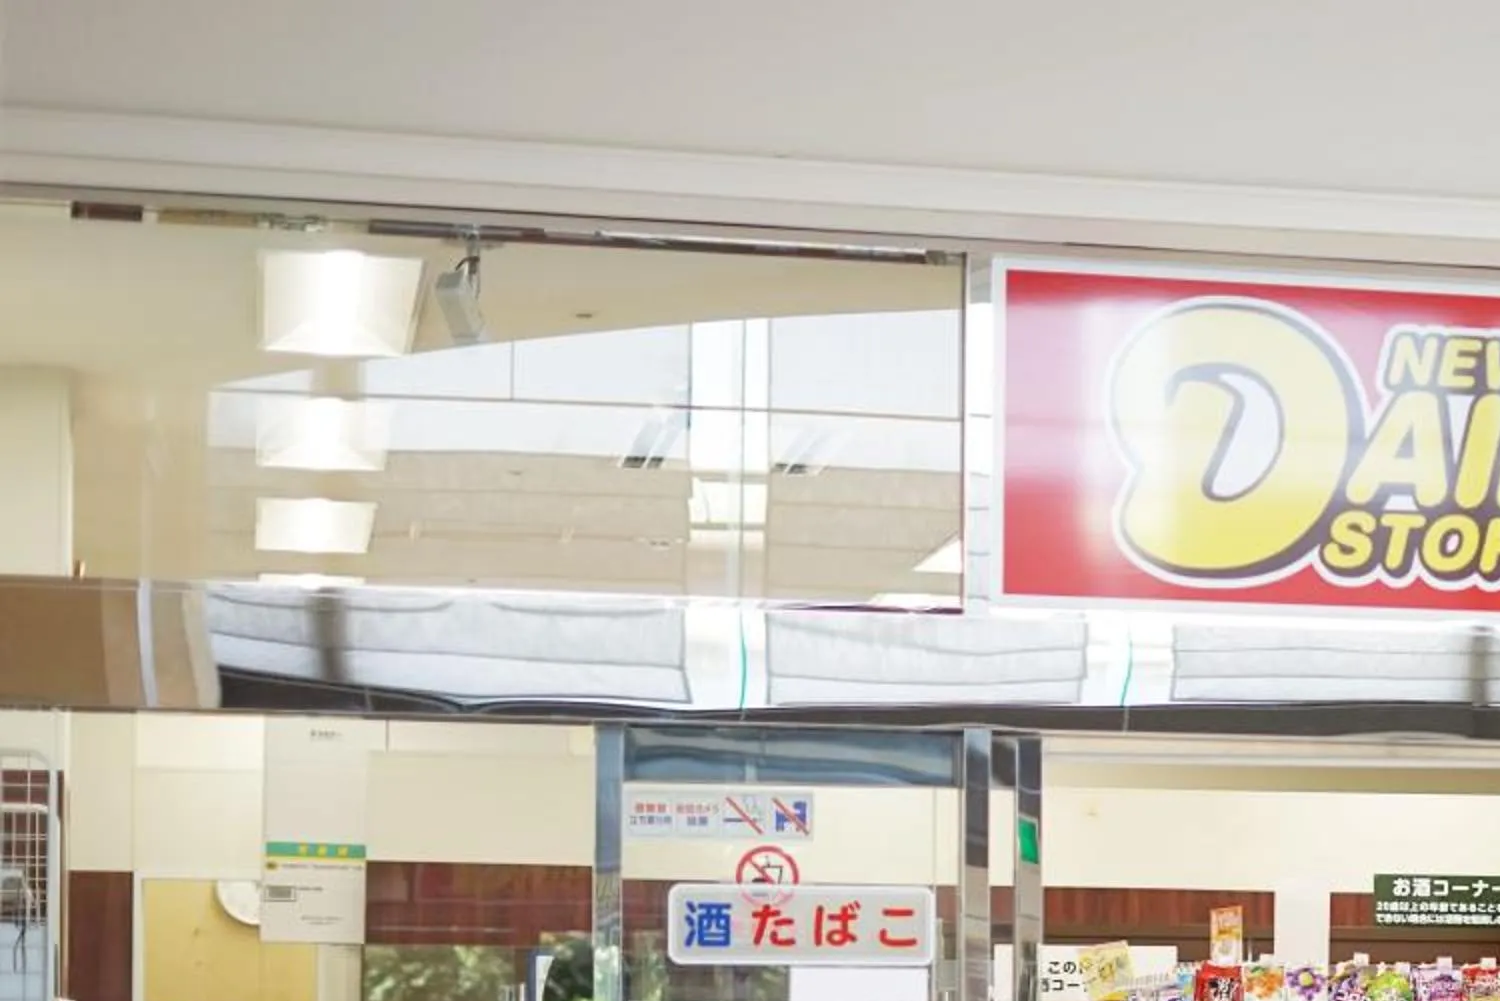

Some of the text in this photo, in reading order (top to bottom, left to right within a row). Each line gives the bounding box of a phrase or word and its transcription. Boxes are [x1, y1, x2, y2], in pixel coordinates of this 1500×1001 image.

[684, 900, 918, 948] 酒 たばこ
[1049, 961, 1084, 975] この
